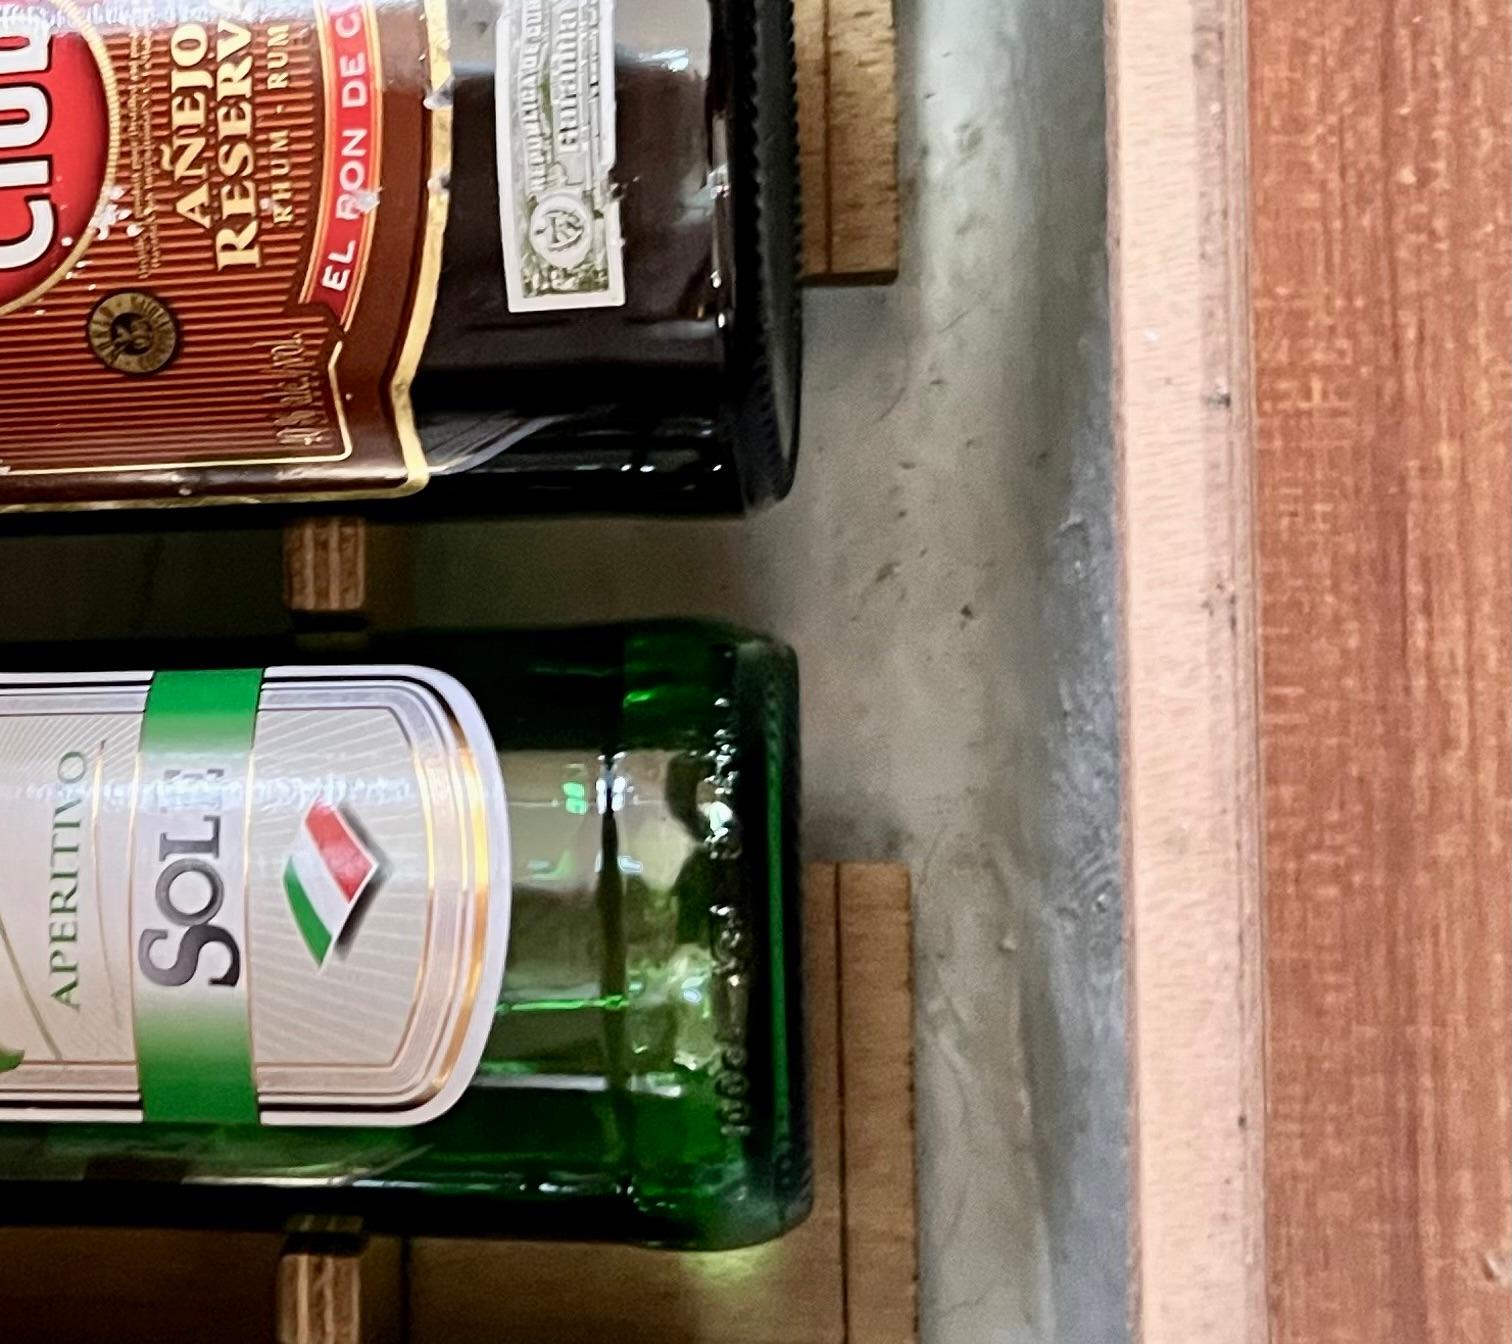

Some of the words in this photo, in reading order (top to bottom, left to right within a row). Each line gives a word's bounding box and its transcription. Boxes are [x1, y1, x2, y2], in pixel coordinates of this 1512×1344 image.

[159, 23, 214, 230] AÑEJO
[265, 23, 291, 90] RUM
[264, 128, 294, 225] RHUM
[320, 239, 357, 293] EL
[340, 51, 369, 109] DE
[47, 751, 88, 1011] APERITIVO
